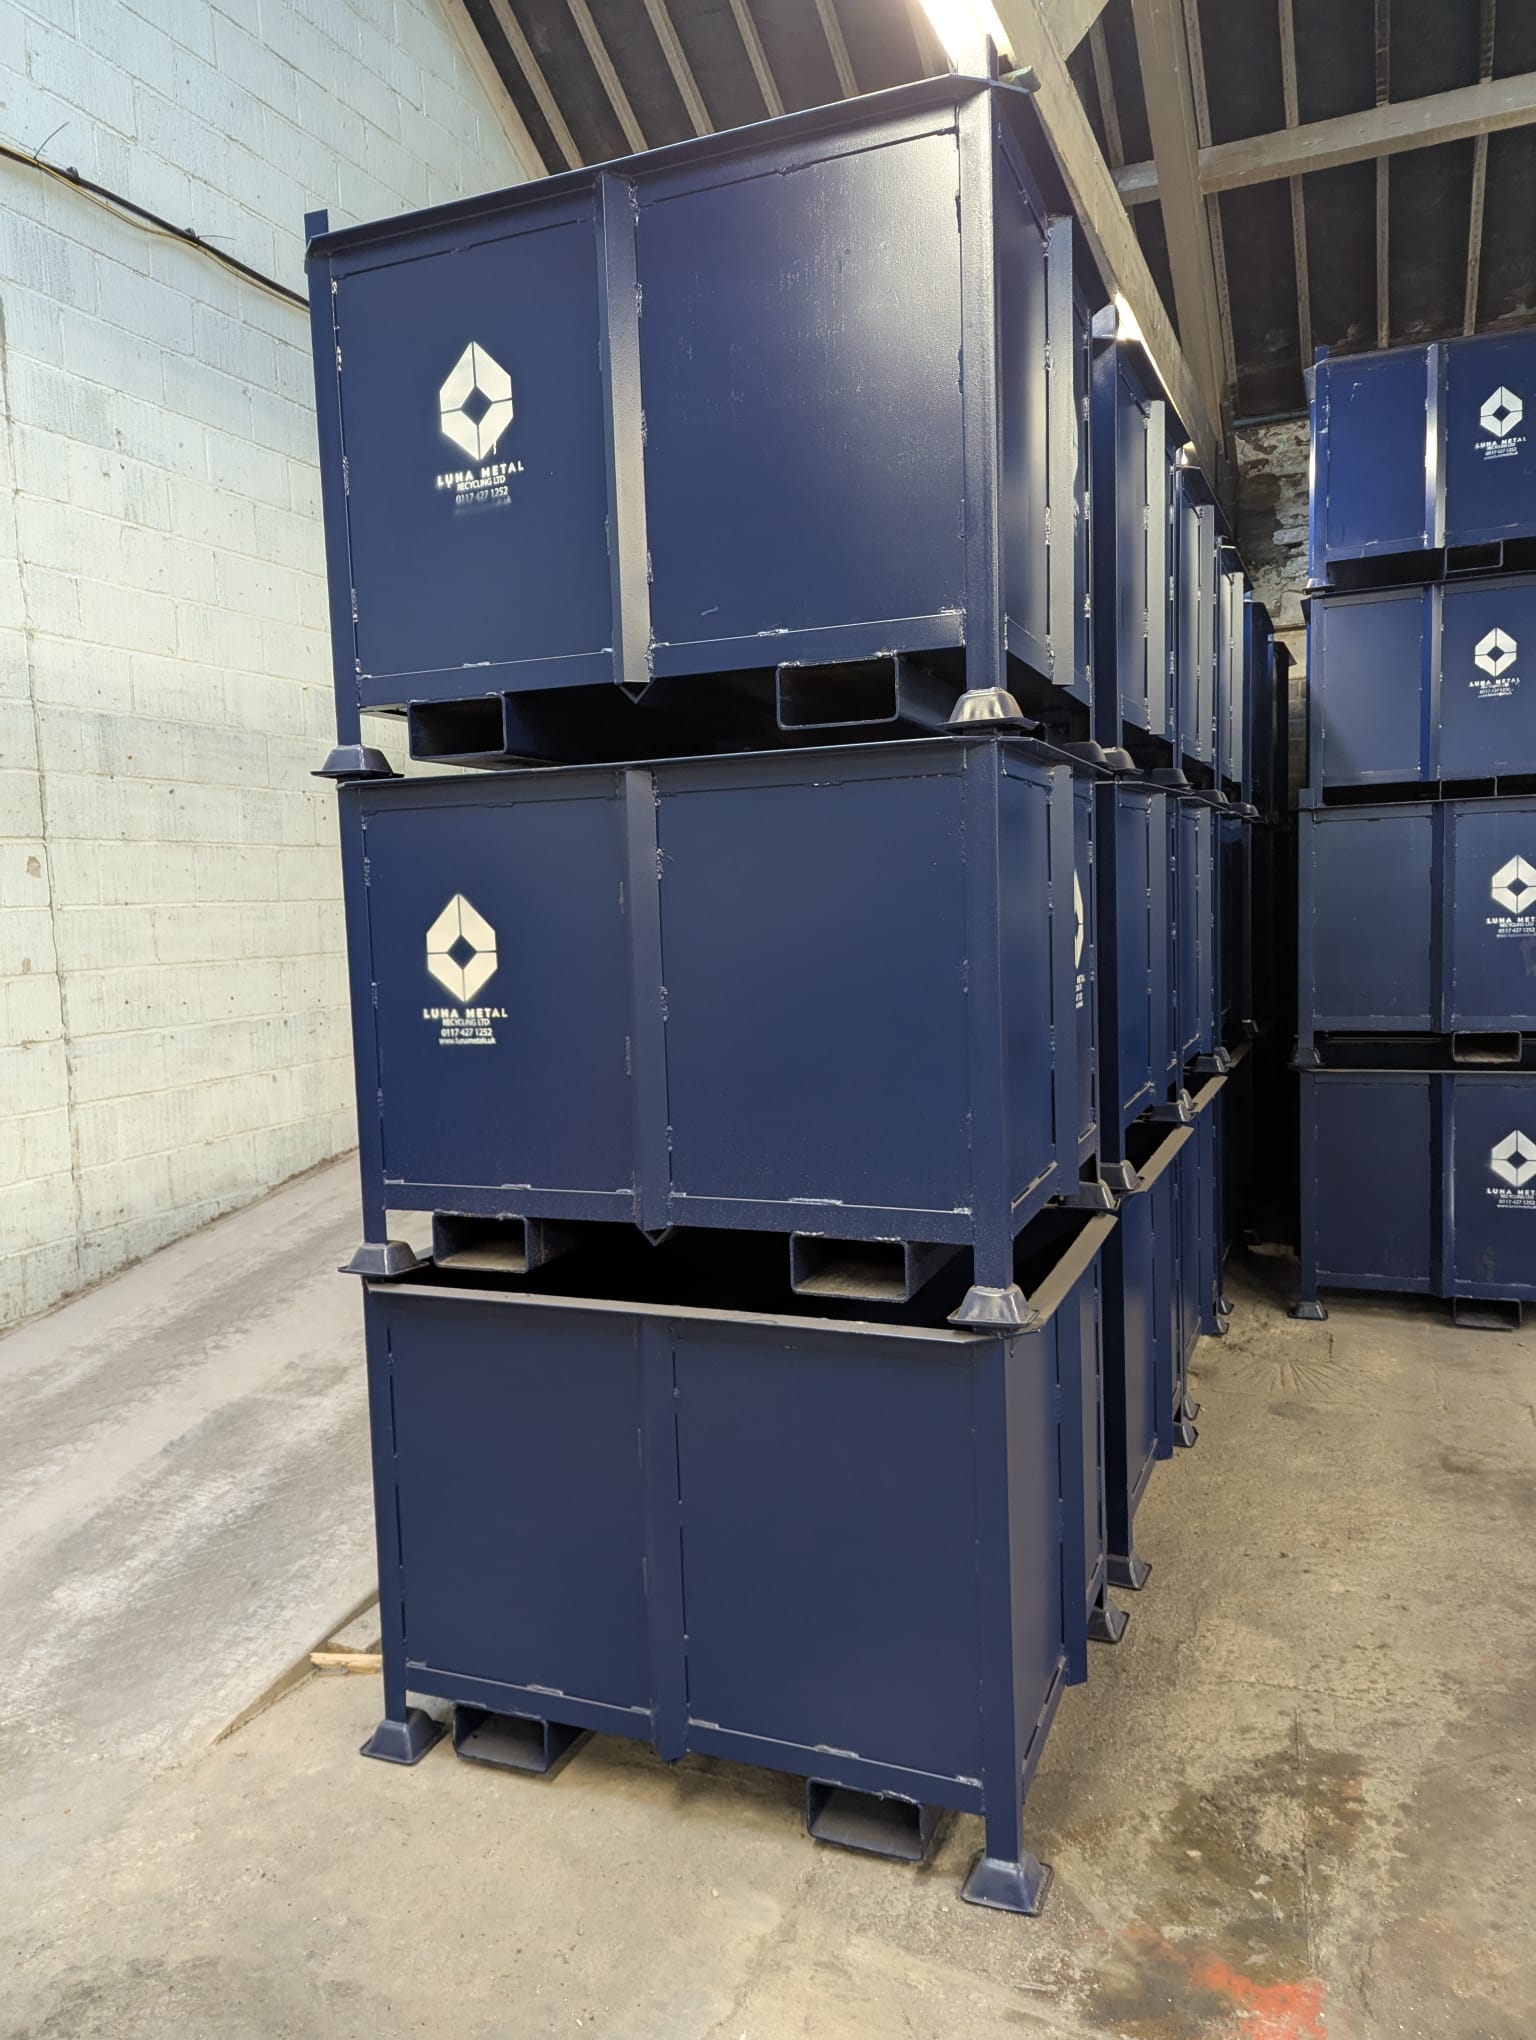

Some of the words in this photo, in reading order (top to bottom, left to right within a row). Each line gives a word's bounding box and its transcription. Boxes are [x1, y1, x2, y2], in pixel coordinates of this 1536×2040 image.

[437, 470, 474, 487] LUNA
[481, 460, 524, 478] METAL
[457, 478, 492, 491] RECYCLING
[493, 475, 506, 484] LTD
[456, 493, 473, 505] 0117
[475, 490, 488, 502] 427
[491, 486, 508, 498] 1252
[422, 1008, 459, 1019] LUNA
[465, 1008, 508, 1018] METAL
[442, 1018, 477, 1027] RECYCLING
[478, 1018, 491, 1027] LTD
[441, 1028, 458, 1038] 0117
[459, 1028, 473, 1037] 427
[475, 1028, 493, 1037] 1252
